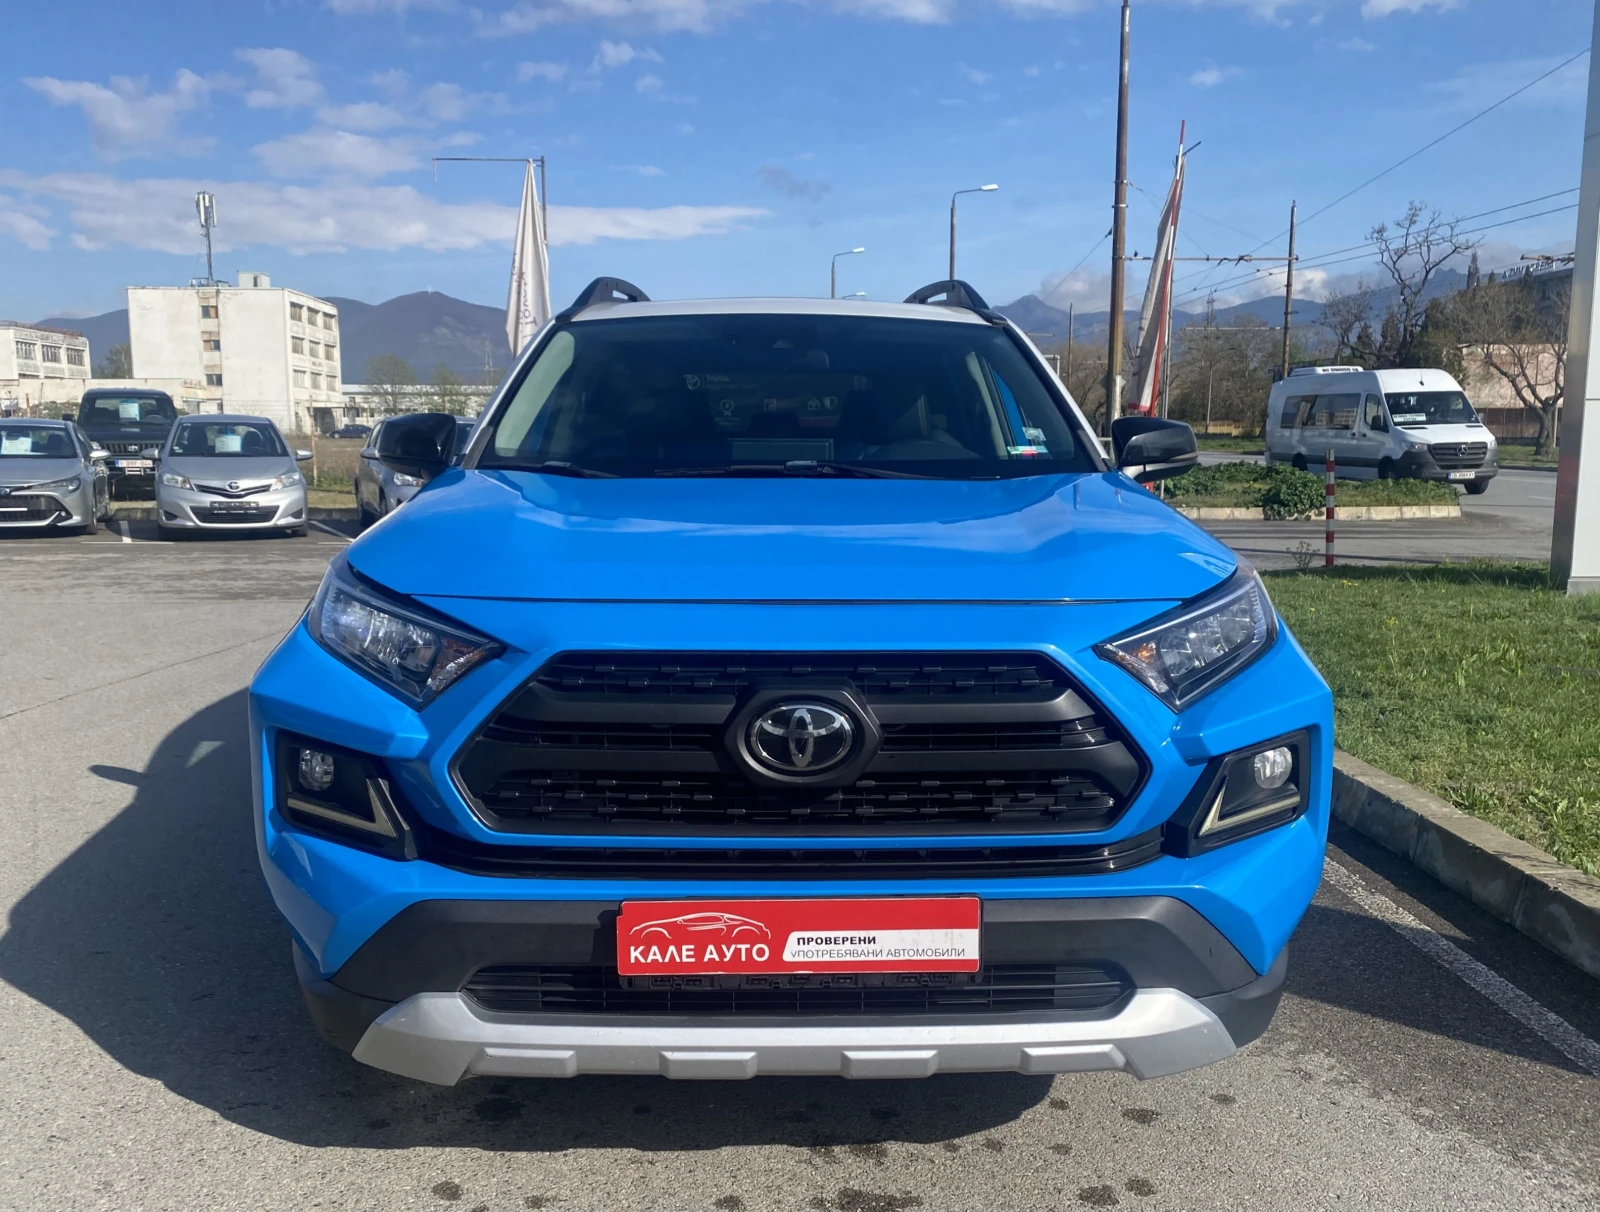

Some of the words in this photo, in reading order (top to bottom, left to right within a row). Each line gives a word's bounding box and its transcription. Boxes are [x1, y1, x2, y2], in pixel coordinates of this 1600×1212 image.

[797, 936, 876, 946] ПРОВЕРЕНИ
[630, 945, 696, 963] КАЛЕ
[703, 944, 770, 962] АУТО
[791, 949, 883, 959] УПОТРЕБЯВАНИ
[886, 948, 965, 958] АВТОМОБИЛИ
